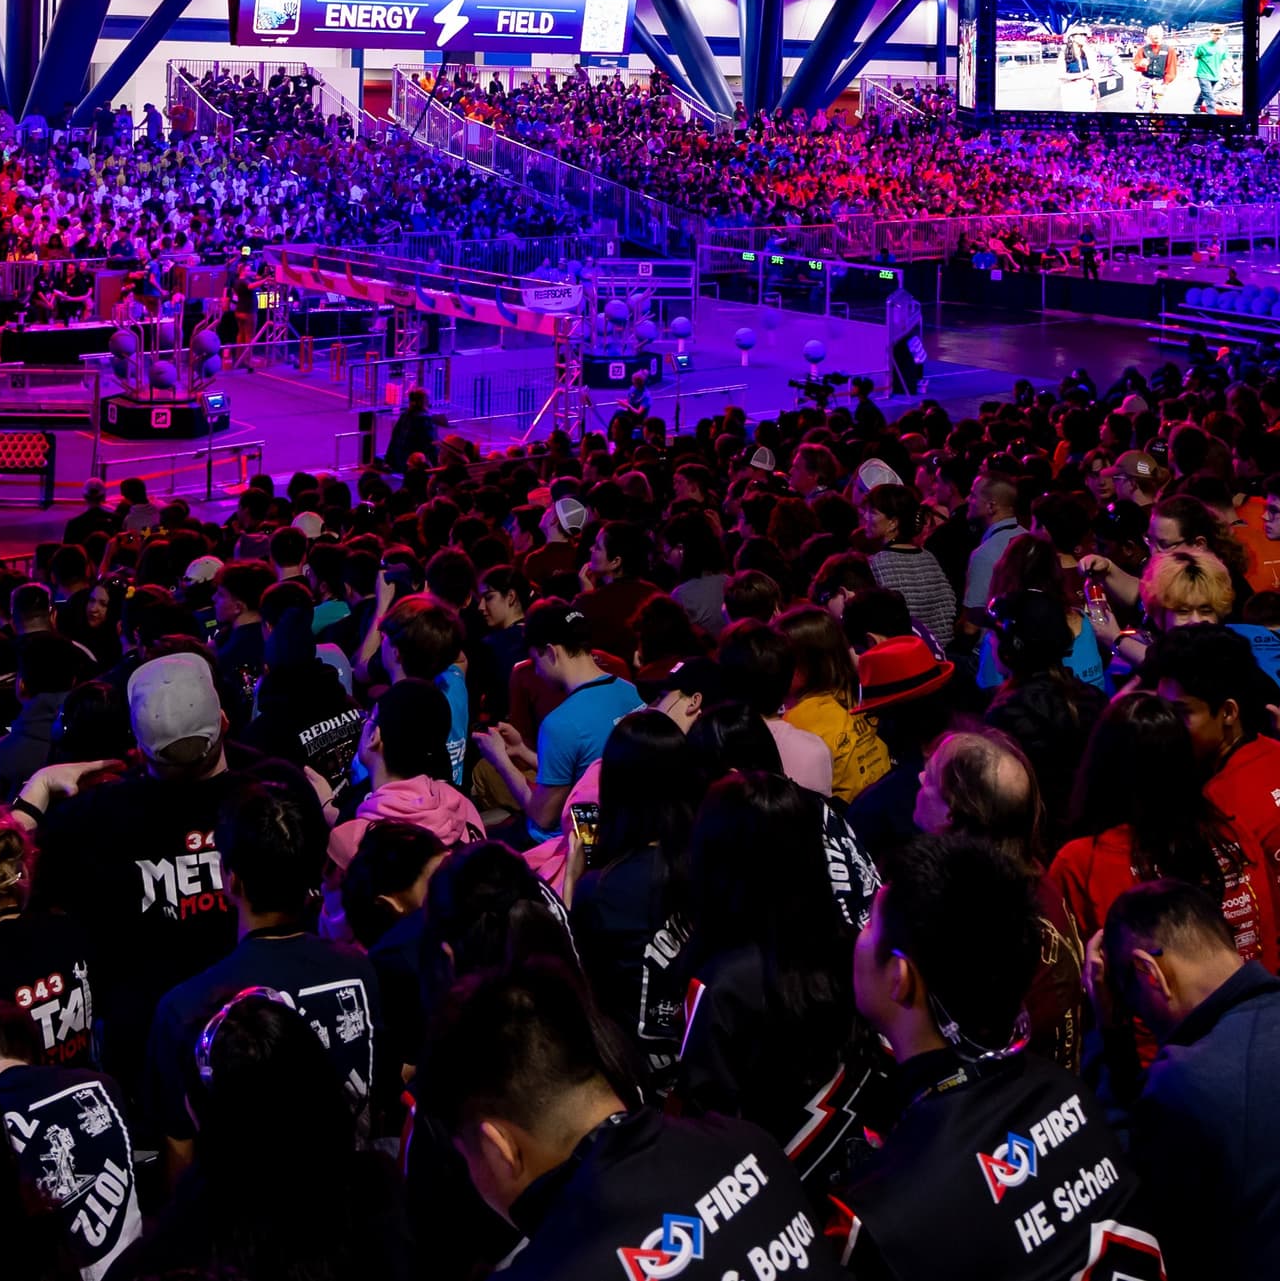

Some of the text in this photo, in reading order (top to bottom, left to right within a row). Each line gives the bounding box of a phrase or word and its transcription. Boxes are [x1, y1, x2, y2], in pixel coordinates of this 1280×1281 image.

[325, 3, 555, 34] ENERGY FIELD
[534, 287, 573, 301] REEFSCAPE
[298, 708, 361, 745] REDHAW
[184, 828, 217, 852] 34
[134, 850, 224, 914] MET
[16, 972, 65, 1008] 343
[30, 959, 93, 1050] TAL
[1029, 1093, 1088, 1158] FIRST
[694, 1153, 769, 1235] FIRST
[1014, 1157, 1120, 1255] HE Sichen
